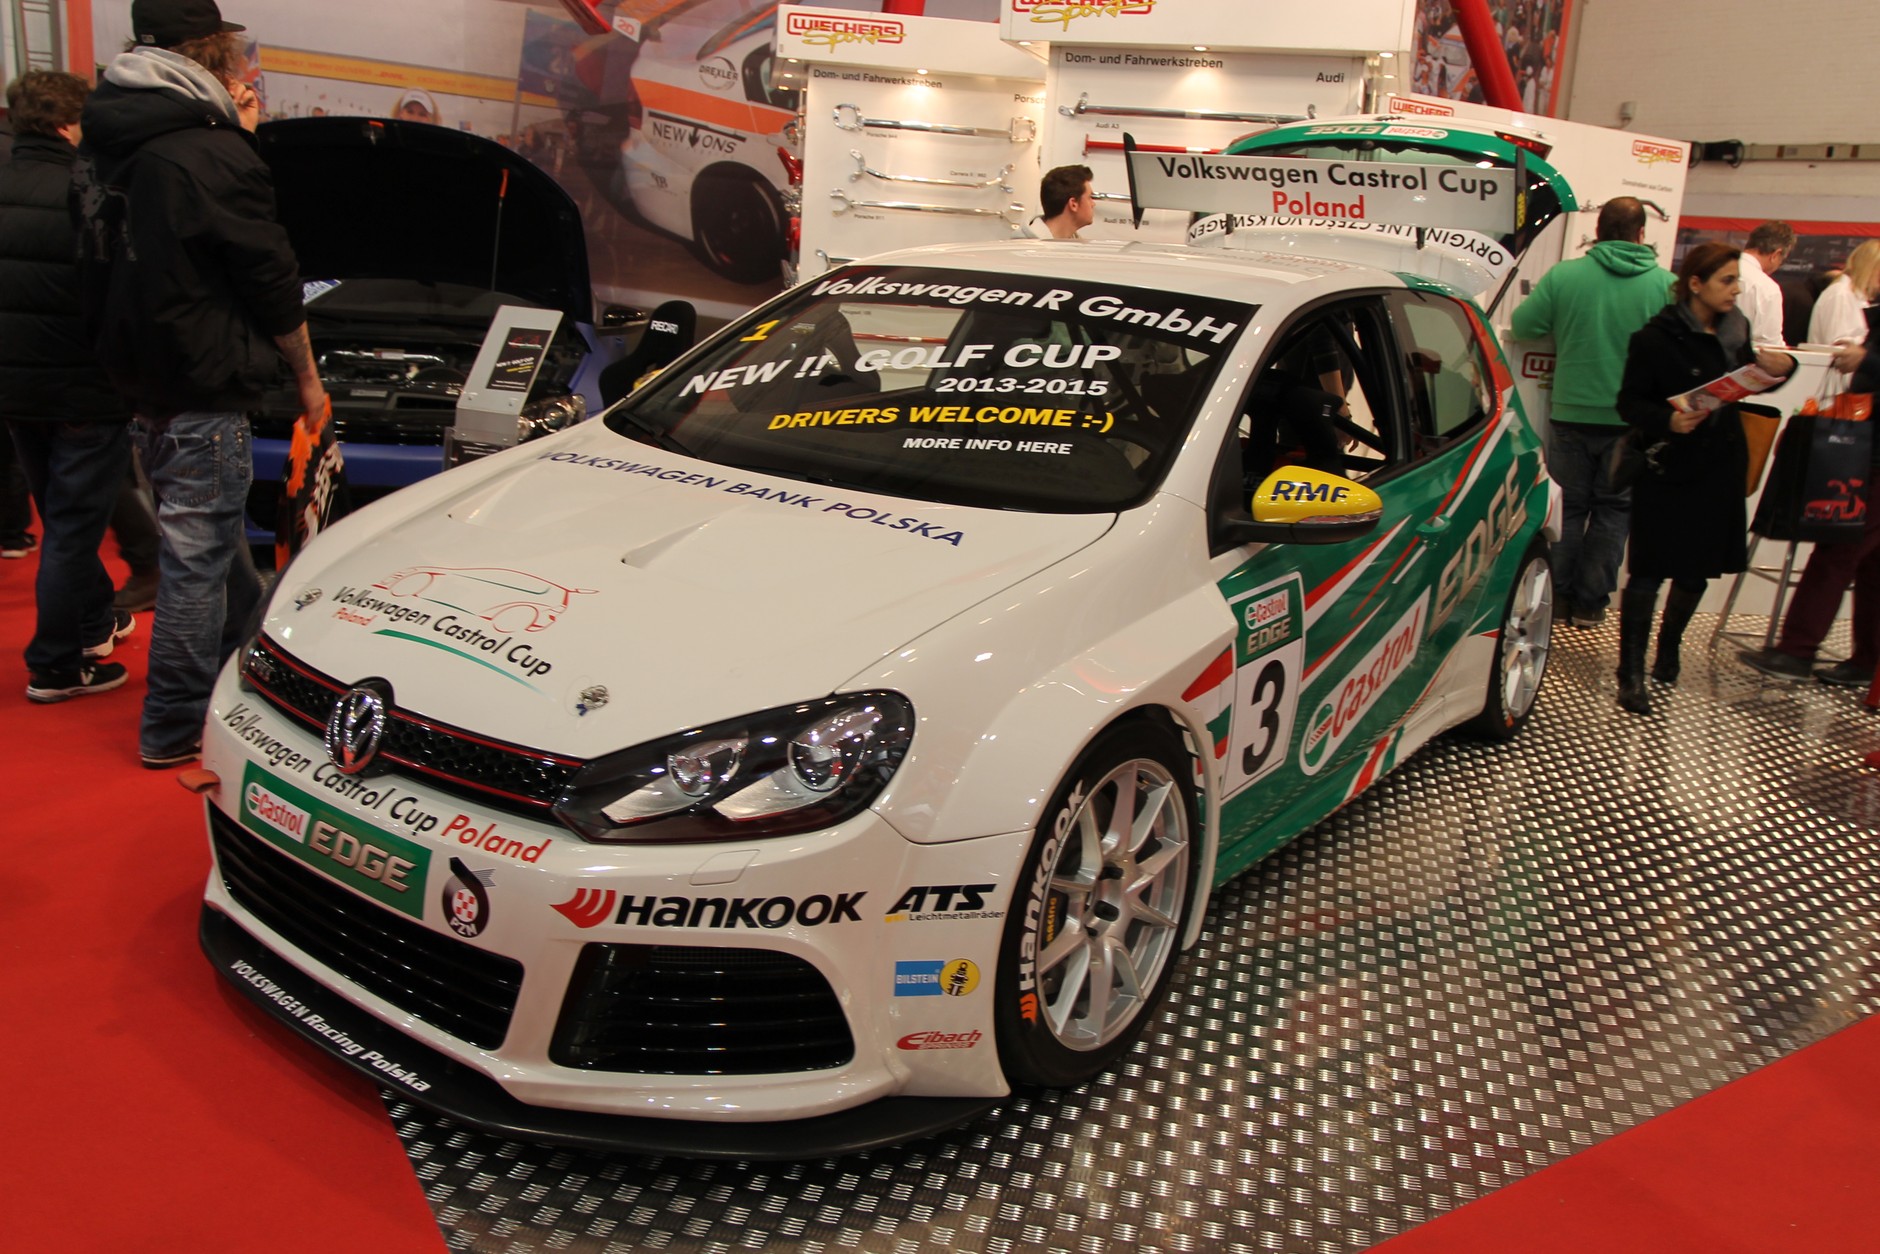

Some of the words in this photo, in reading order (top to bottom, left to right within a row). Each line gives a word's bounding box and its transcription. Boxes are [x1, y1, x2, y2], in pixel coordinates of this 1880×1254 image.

[793, 18, 897, 37] WIECHERS
[802, 26, 907, 54] Sport
[699, 64, 739, 81] DREXLER
[1065, 52, 1096, 63] Dom-
[1099, 54, 1121, 64] und
[1124, 54, 1224, 69] Fahrwerkstreben
[813, 69, 839, 79] Dom-
[842, 72, 861, 82] und
[863, 73, 943, 89] Fahrwerkstreben
[1315, 72, 1345, 84] Audi
[1157, 156, 1319, 188] Volkswagen
[1327, 163, 1428, 191] Castrol
[1438, 169, 1498, 201] Cup
[1272, 190, 1365, 219] Poland
[811, 276, 1034, 306] Volkswagen
[1033, 289, 1074, 311] R
[1078, 296, 1239, 344] GmbH
[650, 319, 679, 335] RECARO
[740, 319, 781, 342] 1
[678, 358, 792, 398] NEW
[793, 354, 831, 379] !!
[854, 343, 995, 373] GOLF
[1002, 343, 1122, 370] CUP
[935, 377, 1109, 397] 2013-2015
[767, 407, 900, 431] DRIVERS
[908, 406, 1077, 428] WELCOME
[902, 437, 963, 450] MORE
[964, 438, 1012, 452] INFO
[1015, 440, 1074, 455] HERE
[537, 450, 727, 489] VOLKSWAGEN
[723, 482, 824, 509] BANK
[822, 502, 965, 547] POLSKA
[1270, 480, 1351, 503] RMF
[1427, 454, 1528, 641] EDGE
[331, 607, 377, 628] Poland
[331, 585, 431, 626] Volkswagen
[432, 614, 513, 655] Castrol
[506, 643, 553, 678] Cup
[1246, 616, 1292, 656] EDGE
[1331, 603, 1422, 739] Castrol
[1242, 659, 1286, 776] 3
[222, 703, 312, 772] Volkswagen
[312, 762, 396, 810] Castrol
[389, 796, 439, 836] Cup
[440, 813, 553, 864] Poland
[257, 788, 304, 836] Castrol
[308, 818, 419, 893] EDGE
[885, 883, 998, 915] ATS
[908, 911, 1006, 922] Leichtmetallräder
[896, 973, 940, 985] BILSTEIN
[229, 958, 311, 1018] VOLKSWAGEN
[301, 1012, 366, 1056] Racing
[359, 1050, 432, 1092] Polska
[896, 1029, 983, 1050] Eibach
